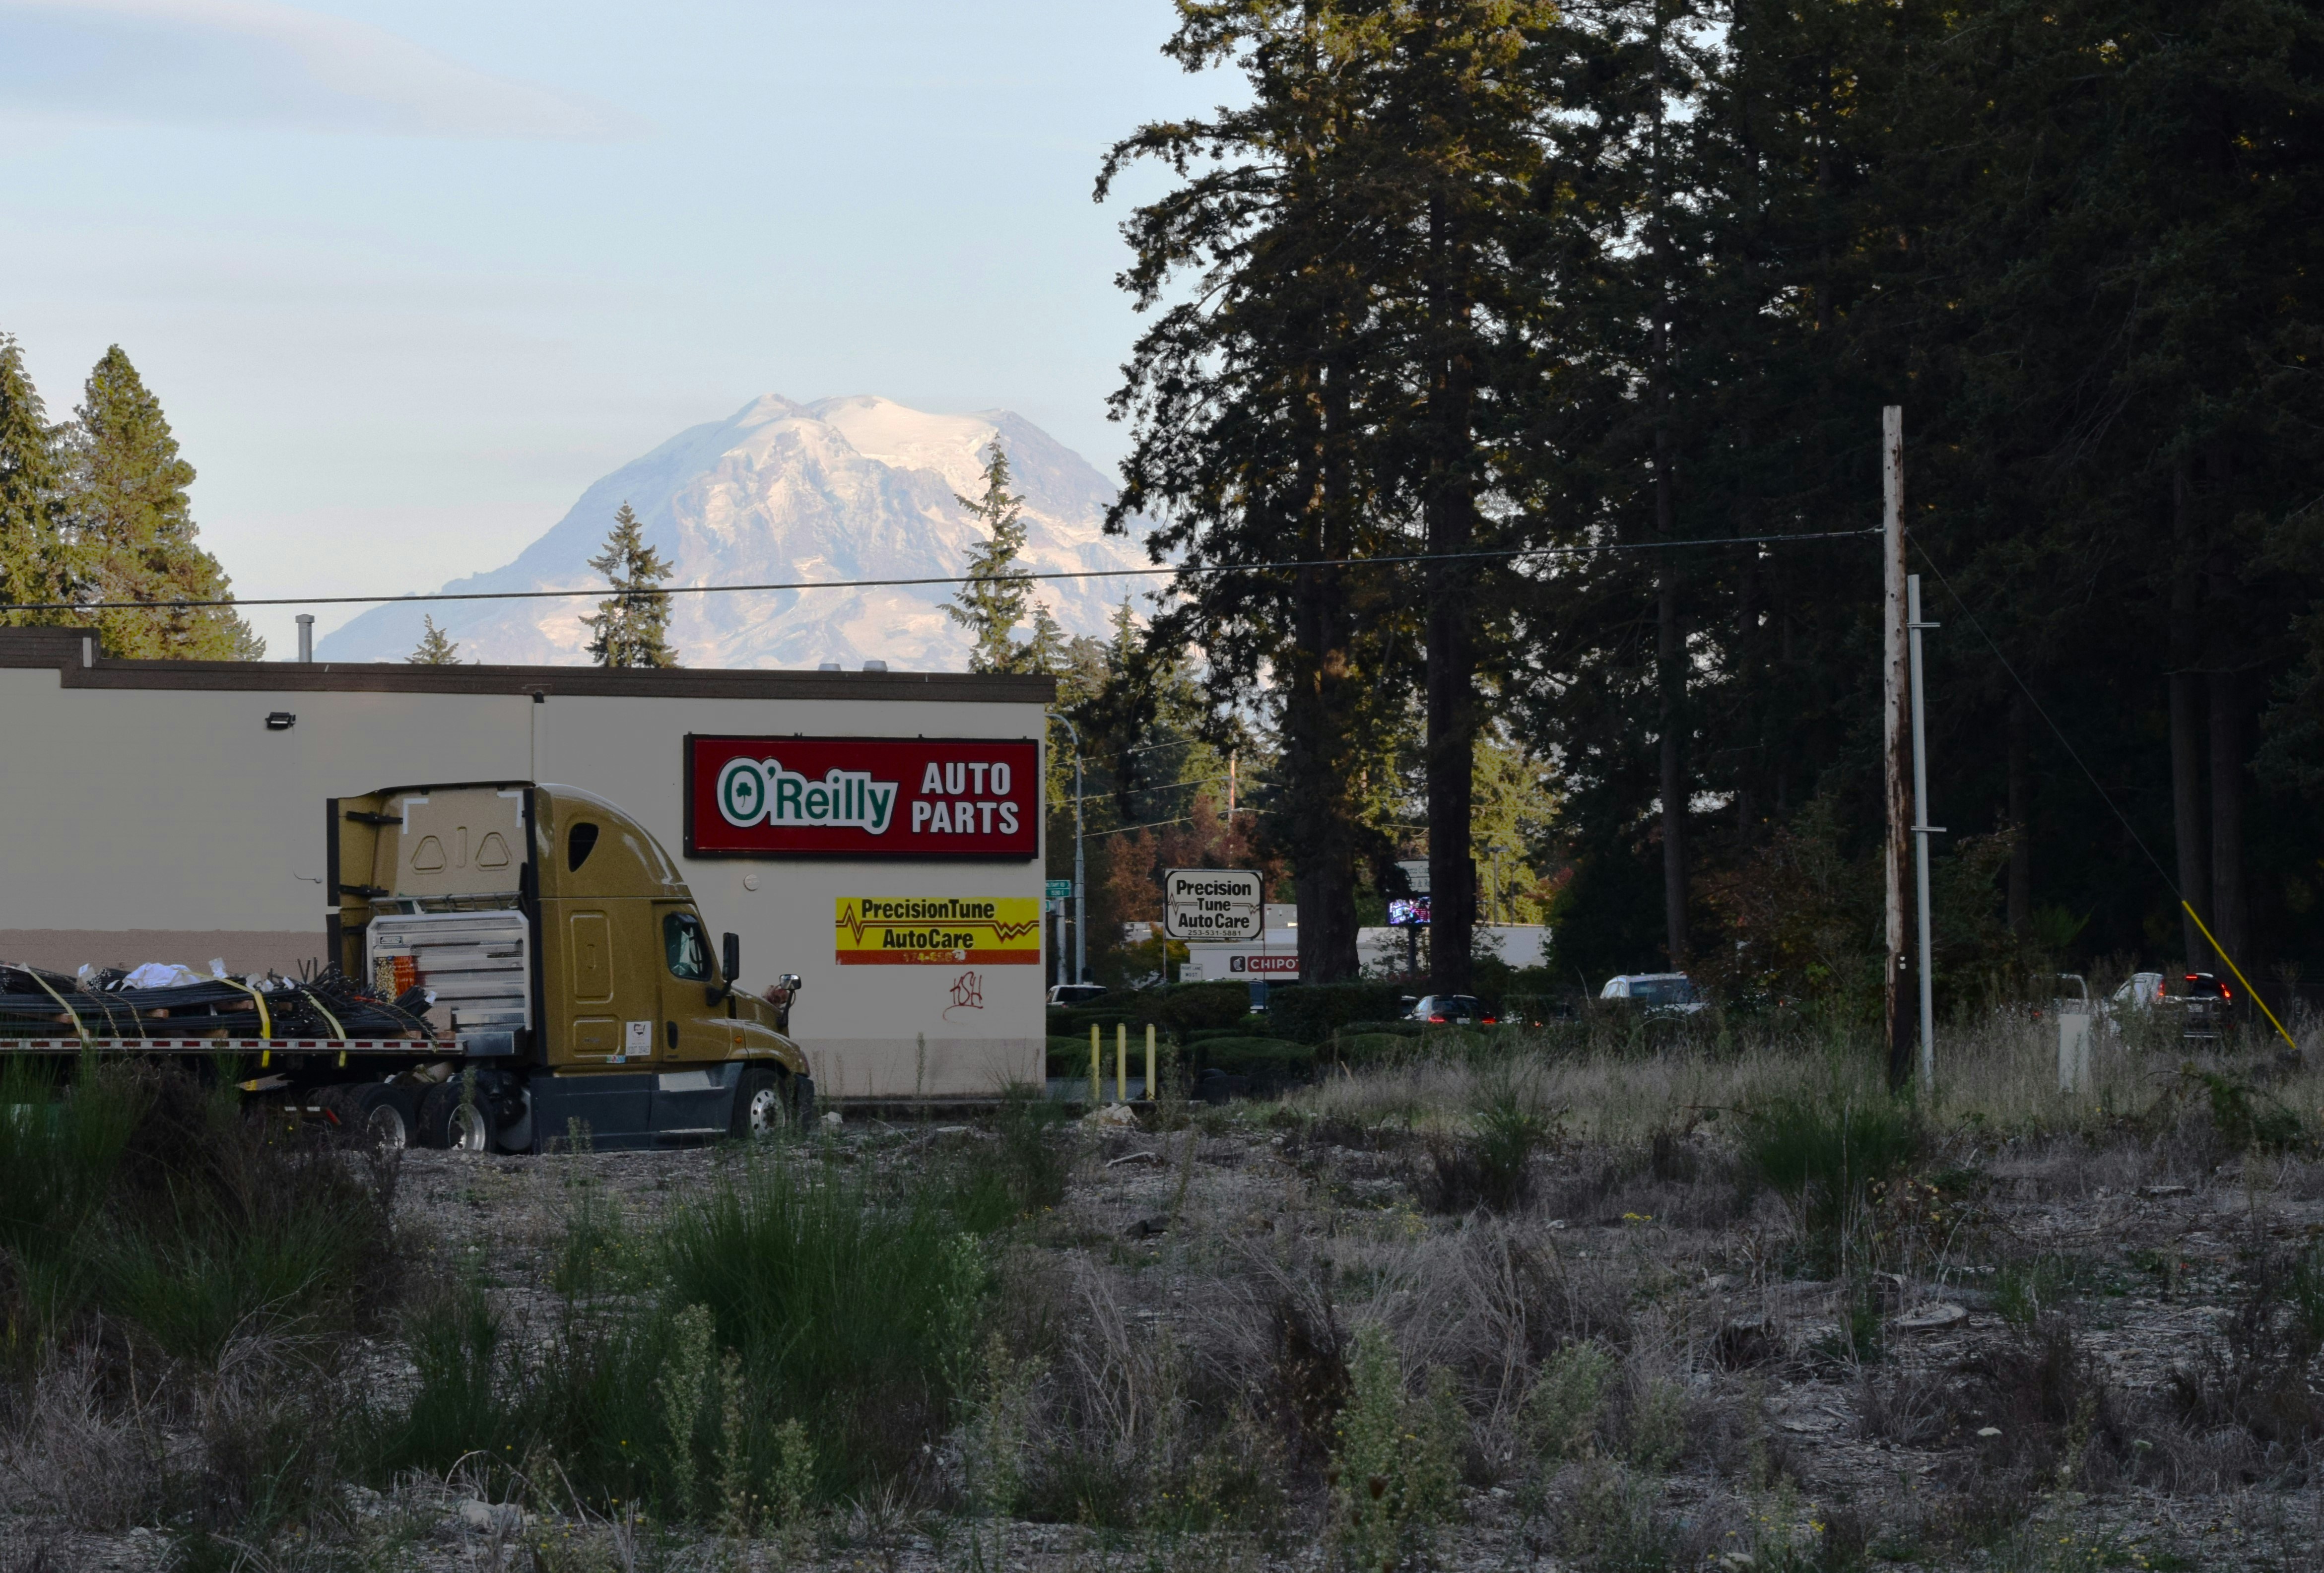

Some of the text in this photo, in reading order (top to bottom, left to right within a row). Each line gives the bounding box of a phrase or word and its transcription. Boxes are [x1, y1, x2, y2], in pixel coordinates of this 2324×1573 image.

[921, 762, 1010, 795] AUTO
[724, 765, 891, 828] O'Reilly
[912, 801, 1019, 834] PARTS
[1176, 880, 1252, 896] Precision
[1197, 898, 1231, 911] Tune
[1178, 913, 1250, 928] Auto Care
[1250, 959, 1299, 969] CHIPO
